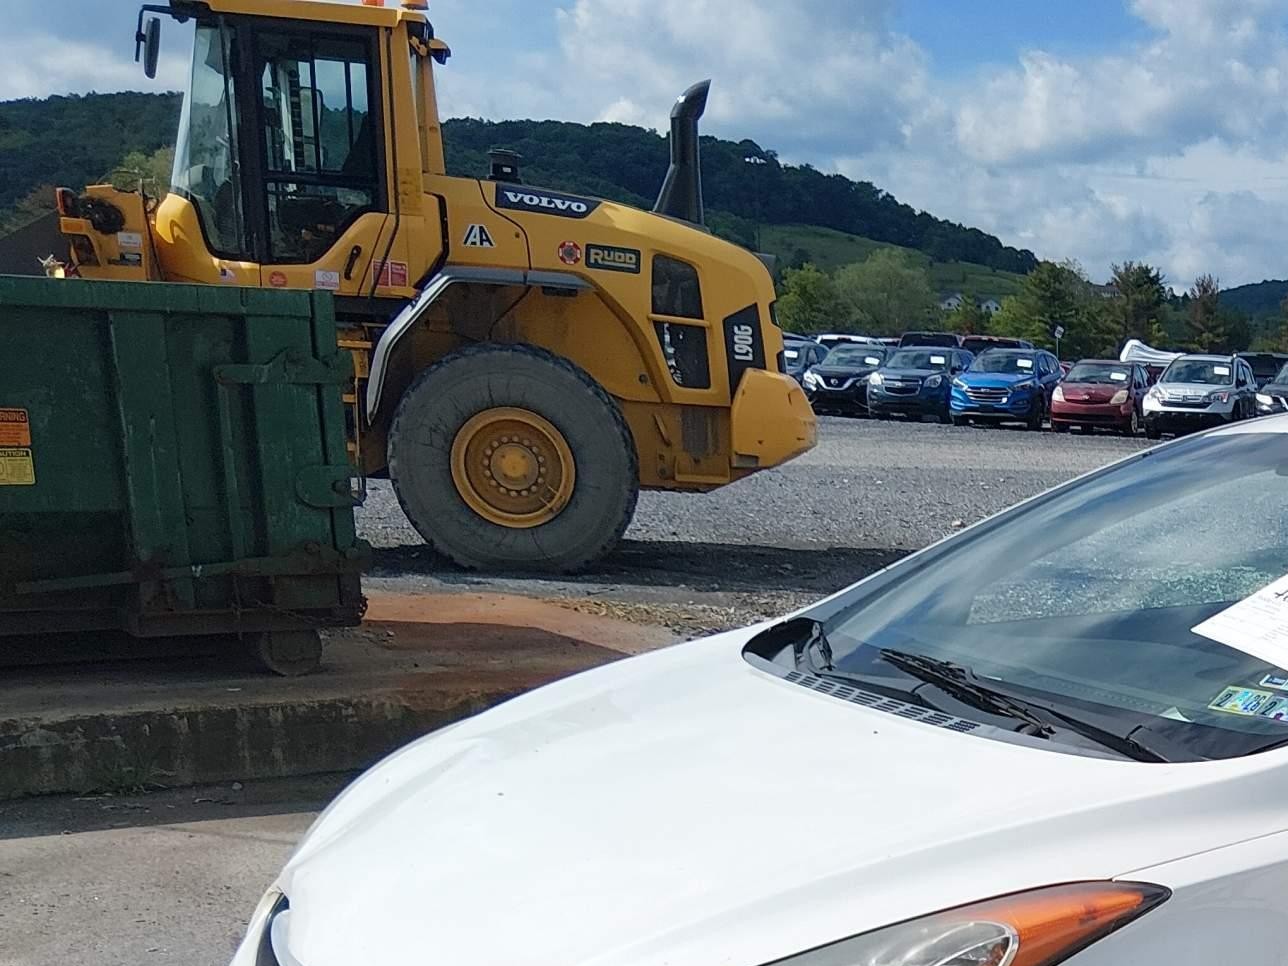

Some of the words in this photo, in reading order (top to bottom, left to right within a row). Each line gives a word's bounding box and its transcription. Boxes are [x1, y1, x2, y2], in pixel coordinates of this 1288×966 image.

[504, 191, 588, 213] VOLVO
[589, 248, 637, 264] RUDD
[733, 324, 754, 361] L90G
[1261, 701, 1278, 716] 2
